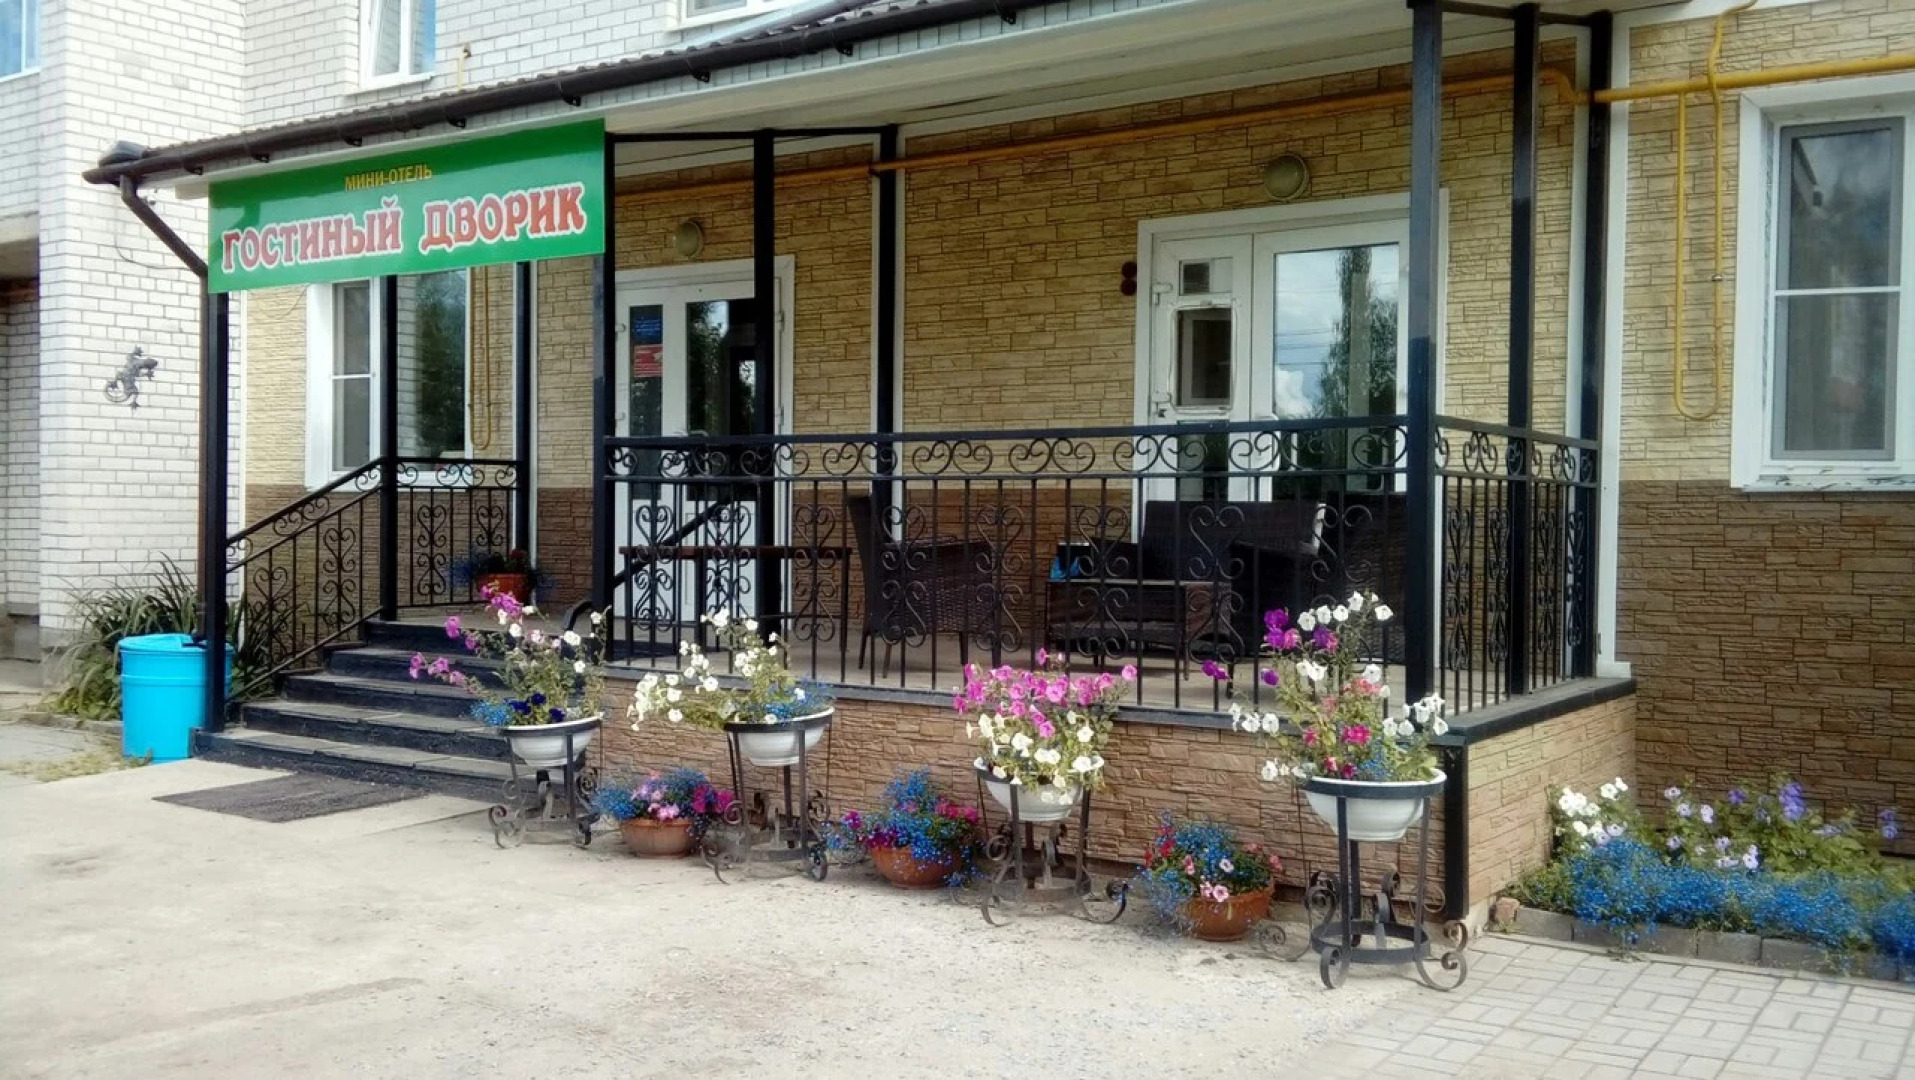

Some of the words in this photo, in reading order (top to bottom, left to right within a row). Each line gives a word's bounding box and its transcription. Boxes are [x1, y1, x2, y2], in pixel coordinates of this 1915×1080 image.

[344, 163, 433, 191] МИНИ-ОТЕЛЬ
[222, 196, 403, 273] ГОСТИНЫЙ
[420, 182, 586, 254] ДВОРИК
